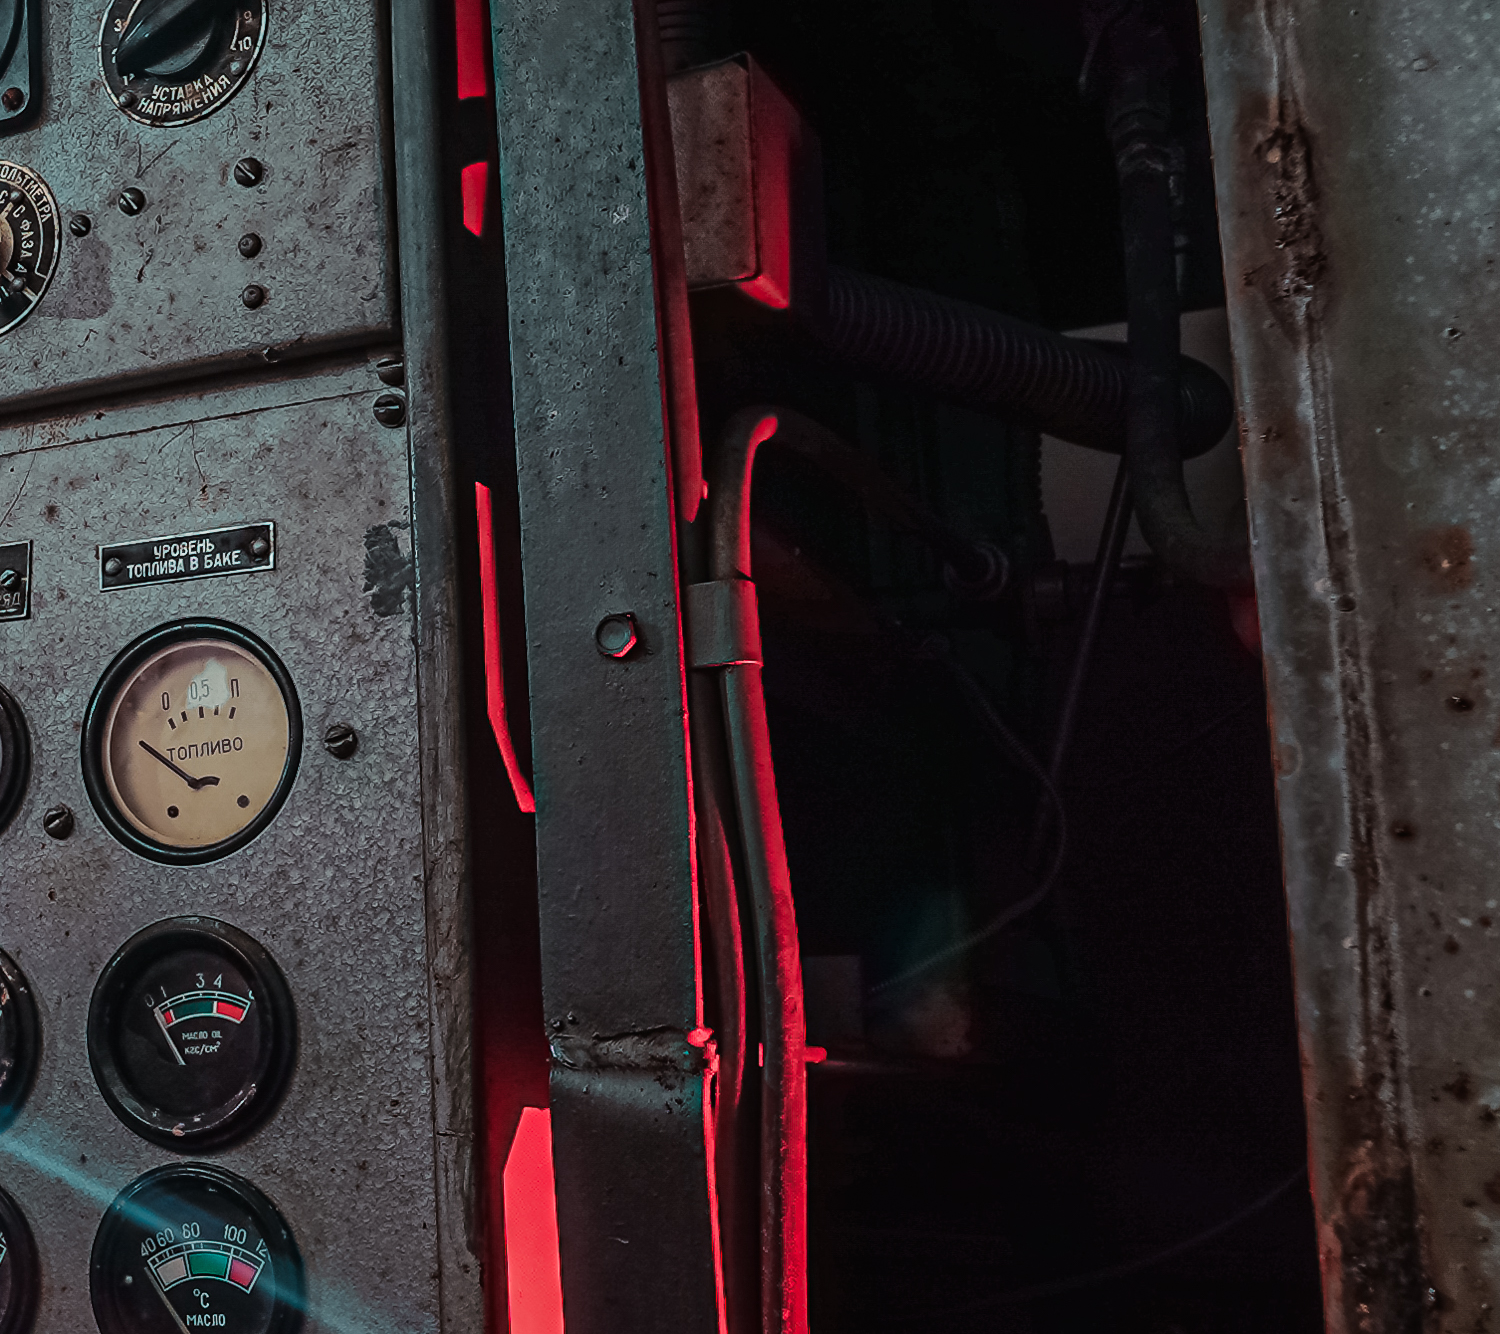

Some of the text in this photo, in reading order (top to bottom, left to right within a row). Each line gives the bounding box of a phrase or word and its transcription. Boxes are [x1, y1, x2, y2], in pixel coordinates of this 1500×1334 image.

[114, 19, 122, 31] 3
[238, 37, 252, 51] 10
[137, 75, 231, 116] НАПРЯЖЕНИЯ
[152, 74, 214, 101] УСТАВКА
[12, 205, 34, 273] С ФАЗА А
[154, 539, 215, 559] УРОВЕНЬ
[126, 549, 242, 579] ТОПЛИВА В БАКЕ
[190, 679, 210, 701] 0,5
[230, 679, 240, 699] П
[166, 736, 244, 763] ТОПЛИВО
[196, 973, 222, 989] 3 4
[140, 1237, 156, 1257] 40
[156, 1227, 174, 1247] 60
[224, 1223, 247, 1245] 100
[186, 1313, 226, 1327] МАСЛО
